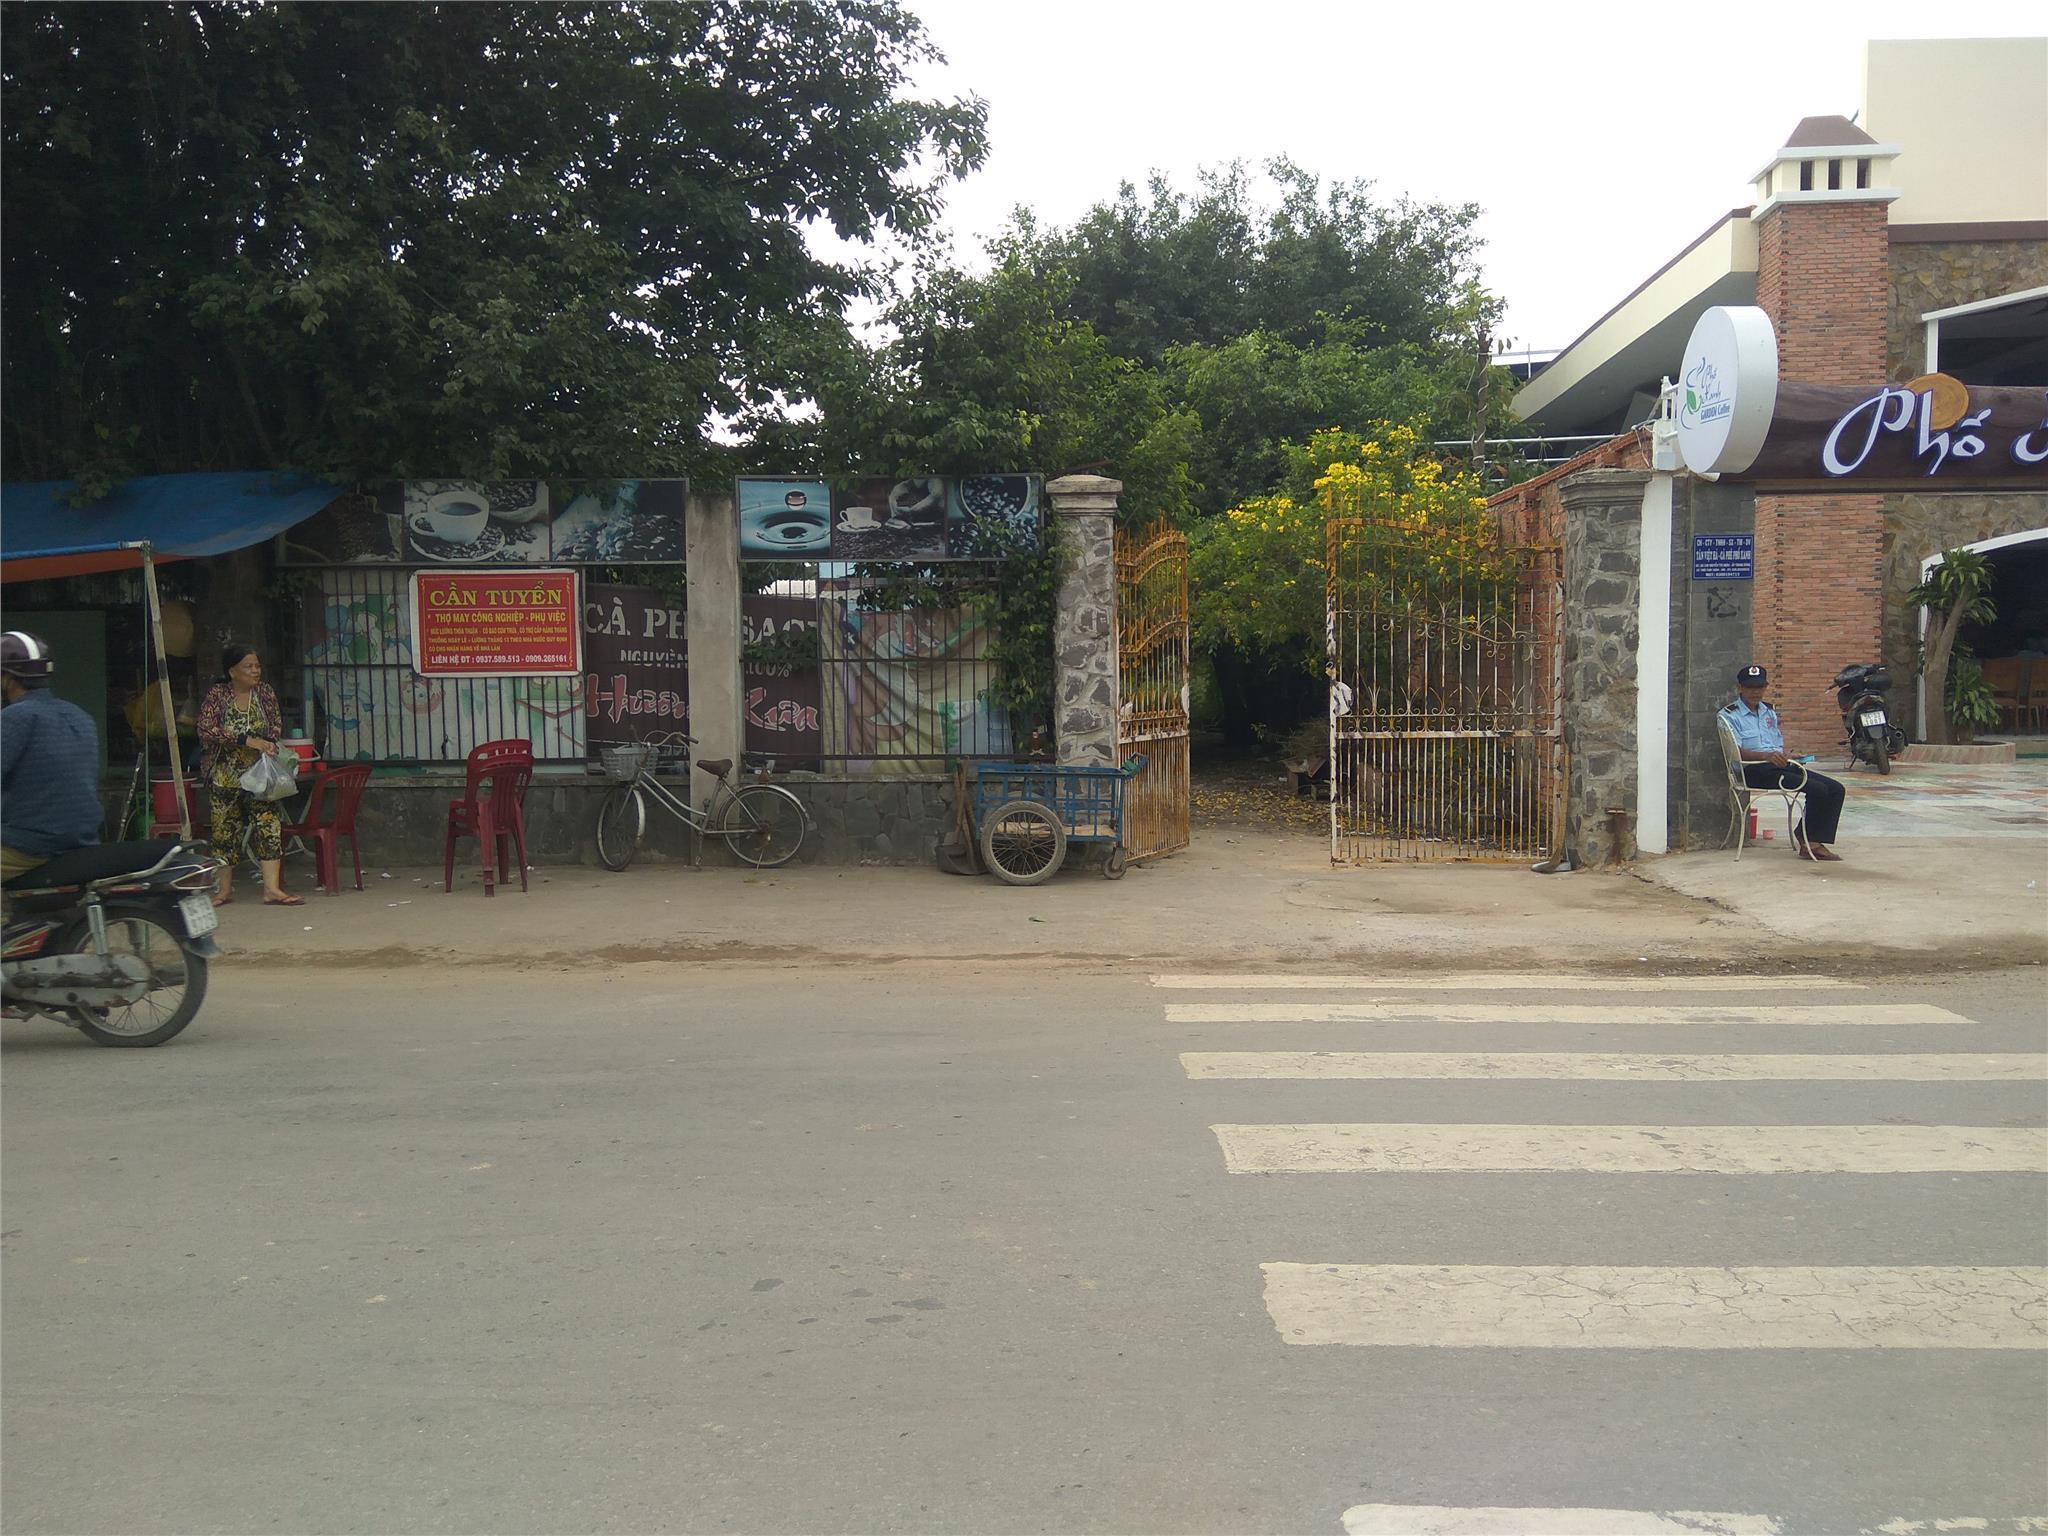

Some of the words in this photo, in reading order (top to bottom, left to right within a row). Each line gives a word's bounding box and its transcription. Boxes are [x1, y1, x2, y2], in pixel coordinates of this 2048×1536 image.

[1821, 386, 1993, 476] Phố
[430, 581, 477, 606] CẦN
[485, 580, 562, 606] TUYỂN
[436, 612, 452, 625] THỢ
[453, 612, 470, 623] MAY
[472, 611, 494, 623] CÔNG
[495, 611, 524, 625] NGHIỆP
[530, 612, 546, 625] PHỤ
[547, 610, 566, 625] VIỆC
[585, 596, 631, 636] CÀ
[643, 608, 688, 640] PH
[431, 654, 448, 664] LIÊN
[449, 653, 460, 666] HỆ
[586, 673, 690, 724] Hươn
